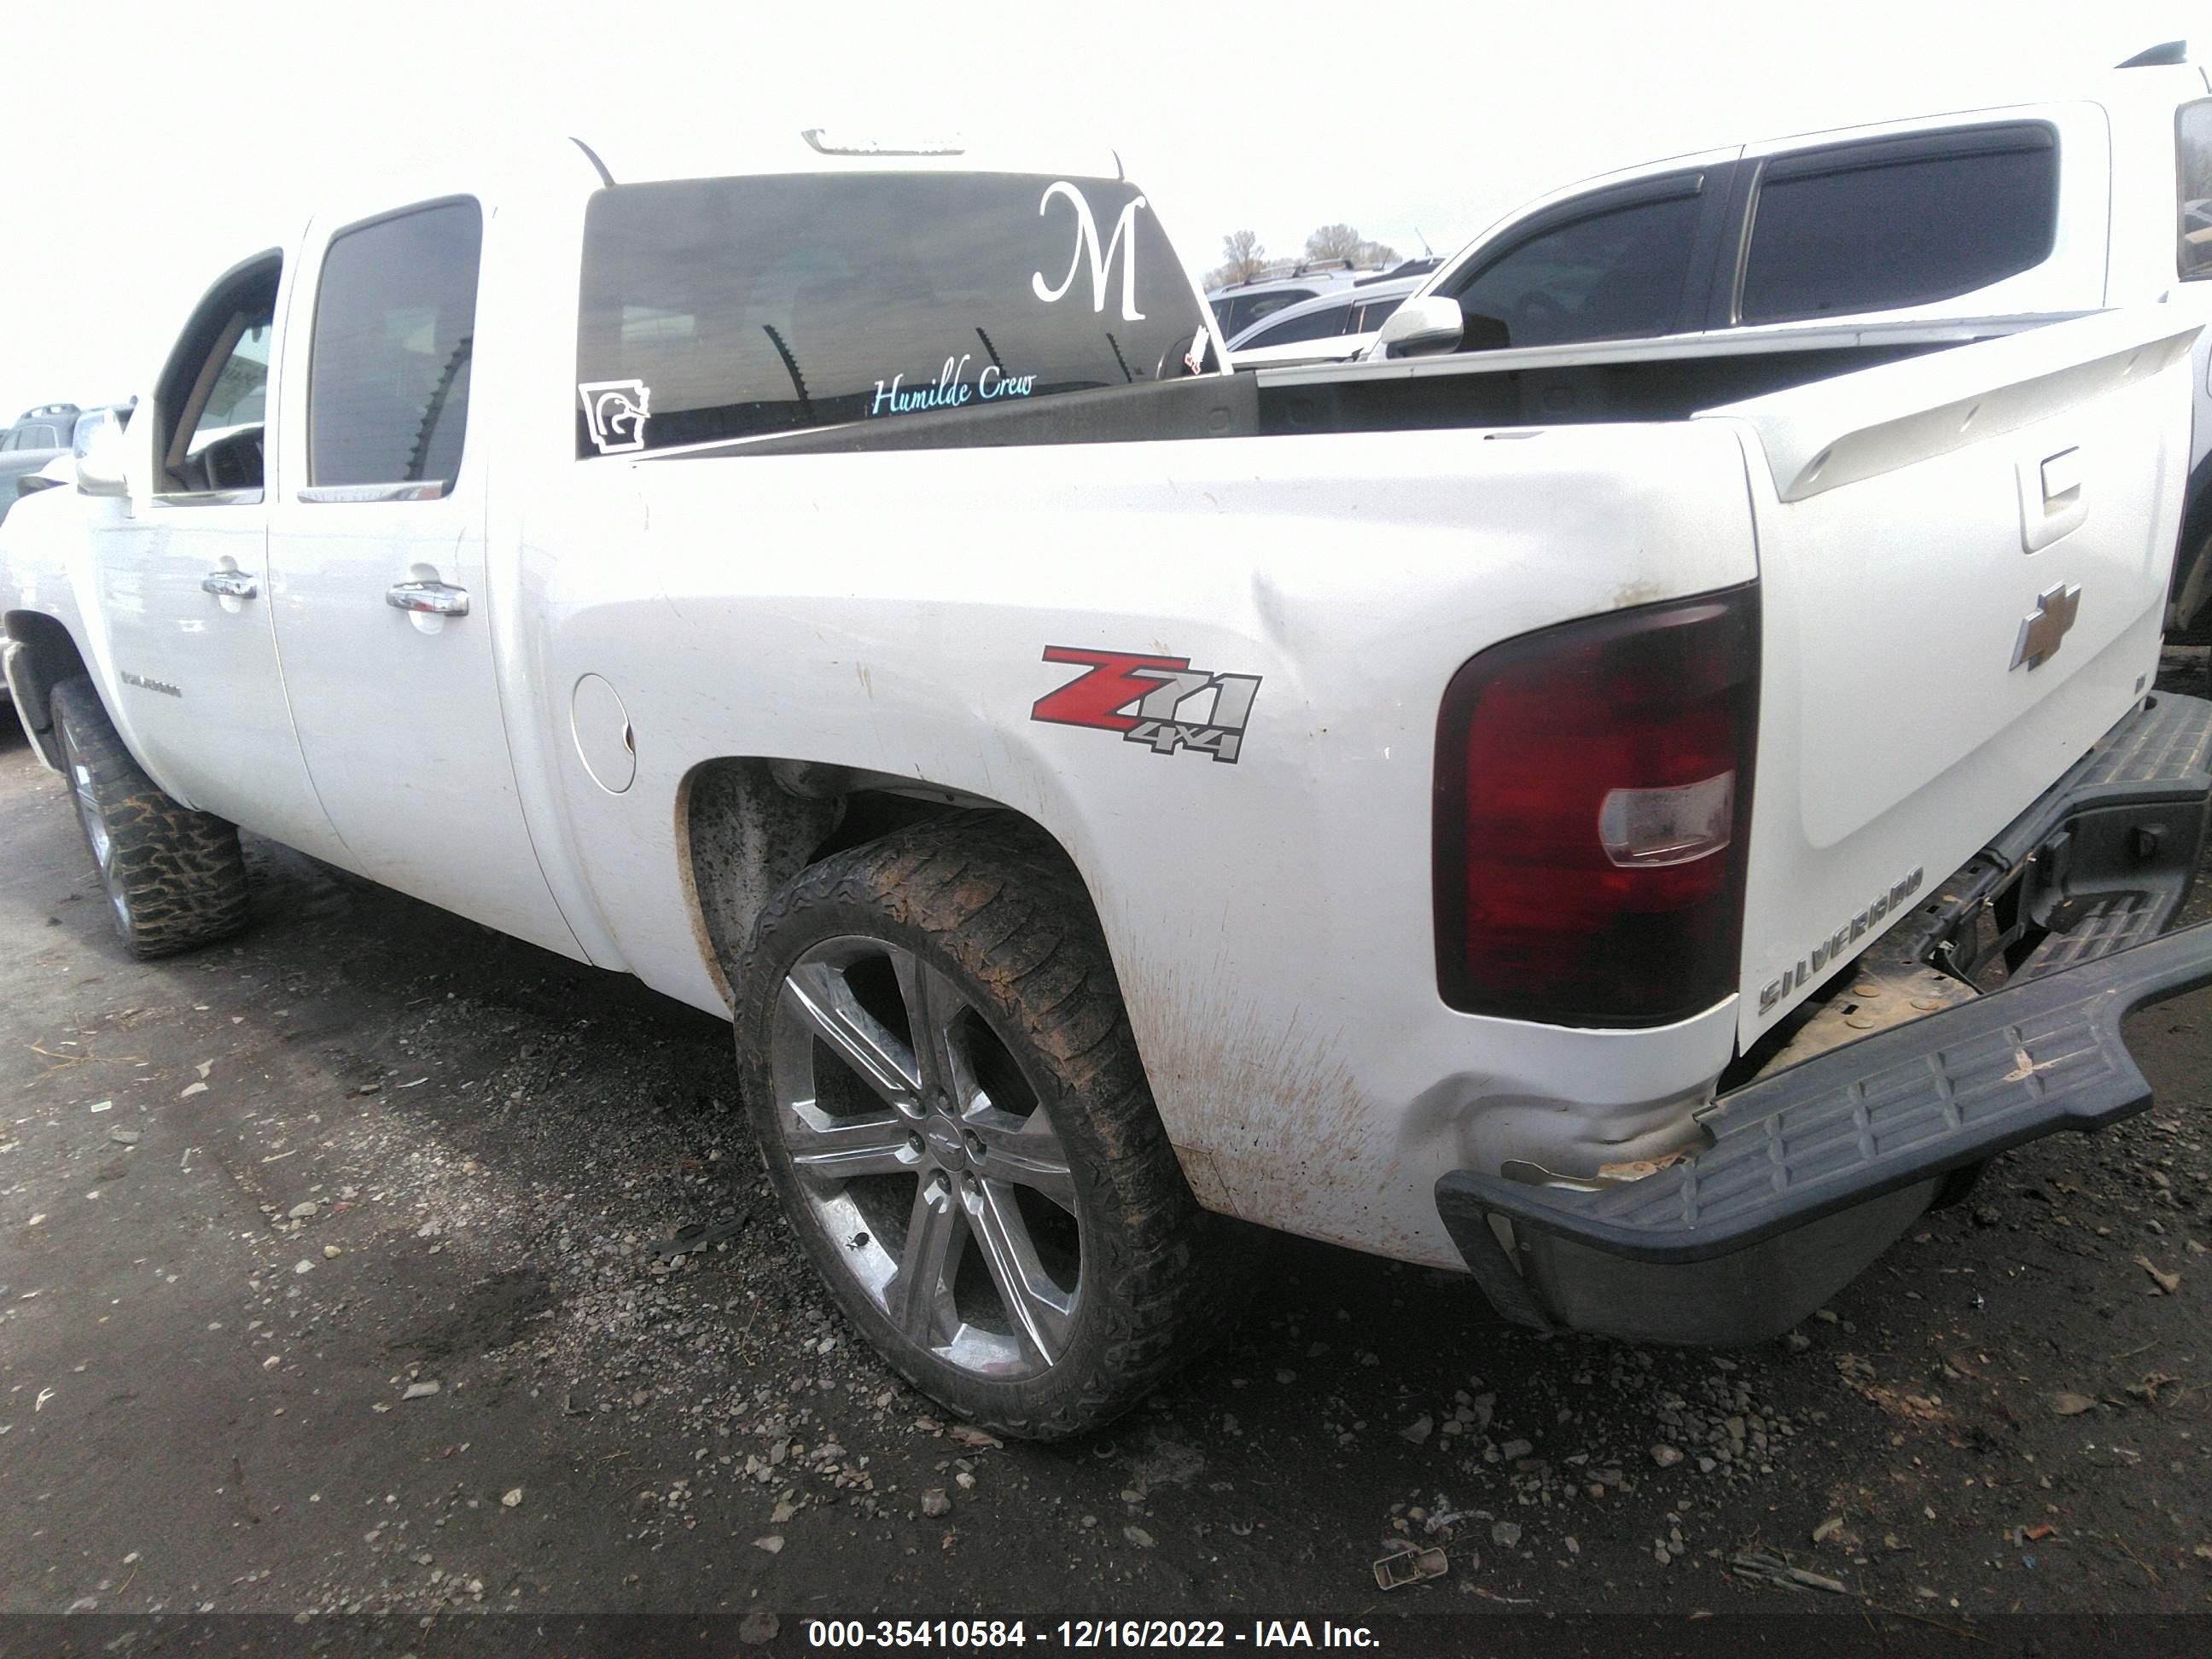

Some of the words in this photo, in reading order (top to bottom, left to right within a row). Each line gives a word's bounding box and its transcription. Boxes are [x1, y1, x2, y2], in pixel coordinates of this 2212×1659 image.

[1032, 180, 1146, 321] M
[871, 354, 973, 415] Humilde
[979, 365, 1038, 399] Crew
[1030, 644, 1263, 731] Z71
[1758, 864, 1924, 1017] SILVERADO
